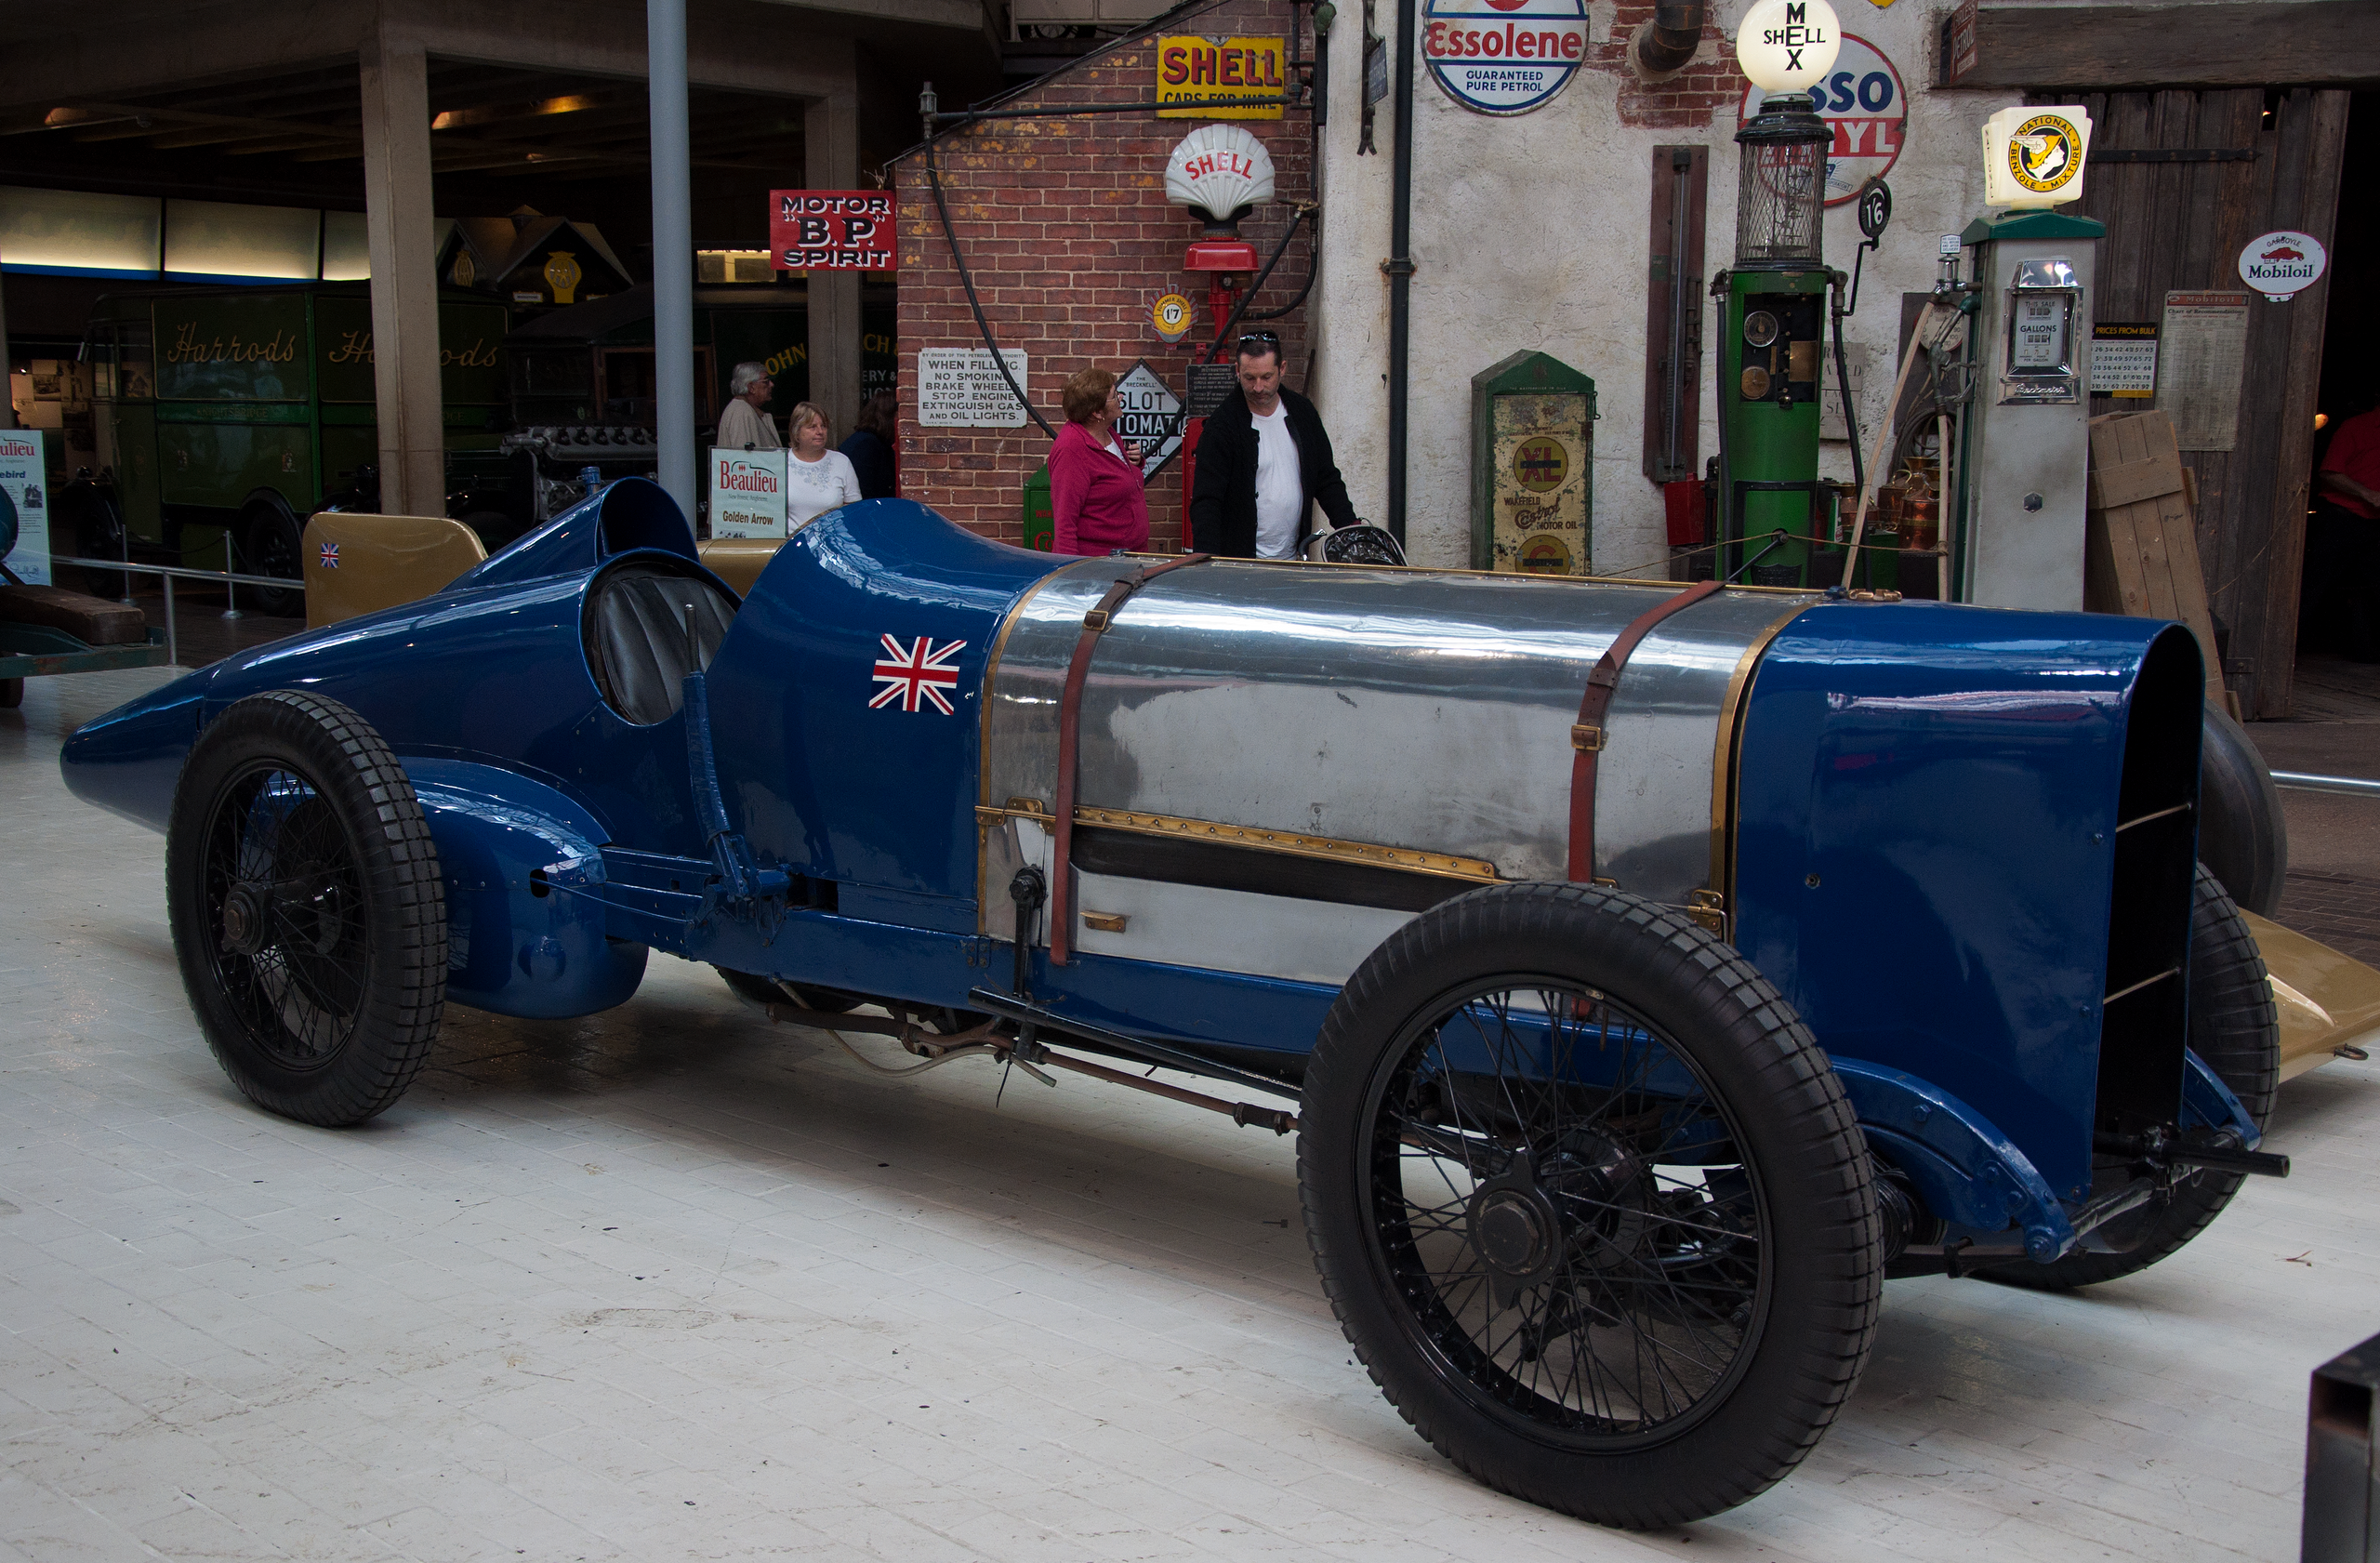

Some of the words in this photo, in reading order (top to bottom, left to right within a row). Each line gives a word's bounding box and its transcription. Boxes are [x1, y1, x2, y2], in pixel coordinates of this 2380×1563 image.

[1426, 21, 1582, 59] Essolene
[1764, 26, 1827, 47] SHELL
[1162, 46, 1283, 87] SHELL
[1466, 70, 1543, 81] GUARANTEED
[1466, 82, 1497, 91] PURE
[1501, 82, 1543, 92] PETROL
[1807, 72, 1894, 113] SSO
[2018, 117, 2074, 136] NATIONAL
[1184, 152, 1253, 180] SHELL
[2010, 149, 2037, 189] BENZOLE
[2051, 144, 2080, 189] MIXTURE
[781, 196, 892, 215] MOTOR
[2267, 236, 2302, 247] GARGOYLE
[783, 249, 891, 268] SPIRIT
[2248, 264, 2313, 278] Mobiloil
[2020, 325, 2056, 333] GALLONS
[168, 322, 296, 363] Harrods
[328, 330, 497, 367] Hods
[764, 342, 807, 376] OHN
[928, 361, 965, 370] WHEN
[971, 361, 1021, 371] FILLNG.
[926, 382, 965, 391] BRAKE
[935, 373, 951, 381] NO
[922, 402, 993, 410] EXTINGUISH
[972, 392, 1015, 401] ENGINE
[1118, 391, 1166, 410] SLOT
[951, 412, 969, 420] OIL
[973, 412, 1019, 420] LIGHTS.
[0, 443, 35, 457] ulieu
[0, 470, 26, 479] ebird
[1522, 447, 1562, 483] XL
[720, 461, 777, 493] Beaulieu
[1504, 497, 1540, 506] WAKEFIELD
[722, 510, 749, 523] Golden
[750, 512, 774, 525] Arrow
[1514, 497, 1561, 530] Castrol
[1537, 521, 1563, 530] MOTOR
[1565, 521, 1578, 530] OIL
